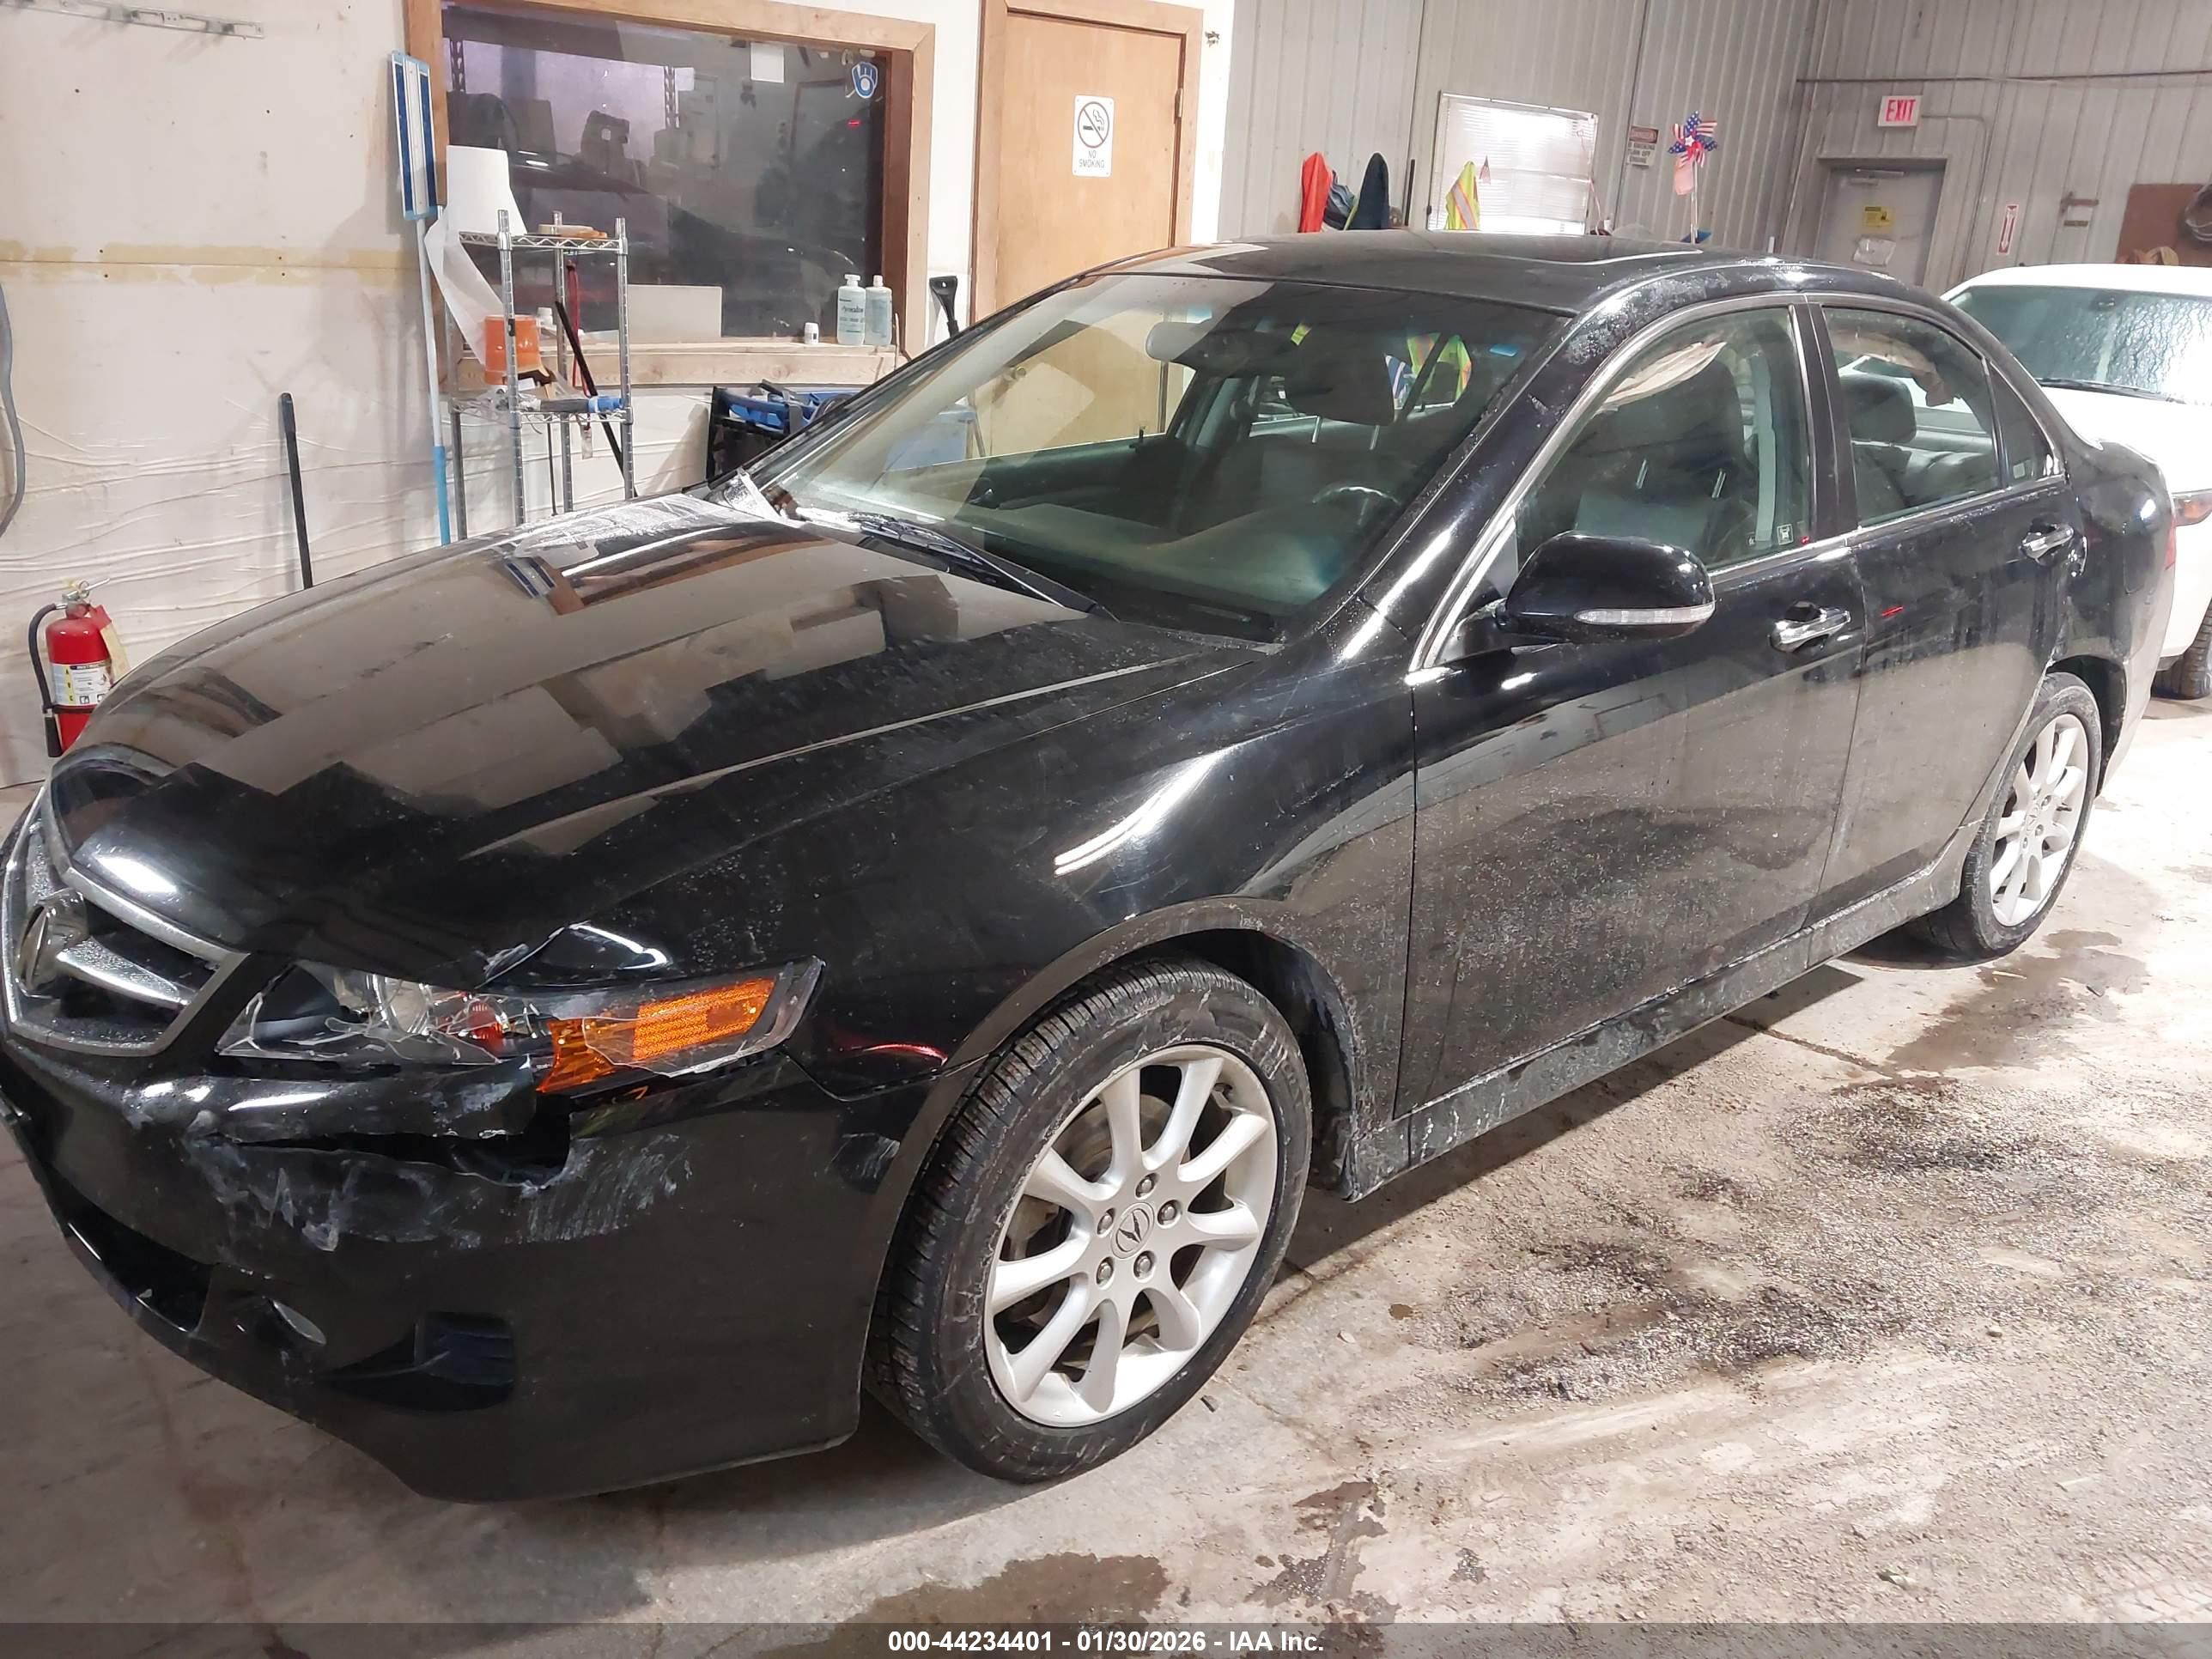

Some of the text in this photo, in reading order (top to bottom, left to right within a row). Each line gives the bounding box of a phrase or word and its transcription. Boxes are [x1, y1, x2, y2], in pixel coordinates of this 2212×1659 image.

[1886, 99, 1916, 122] EXIT
[1088, 149, 1097, 159] NO
[1079, 158, 1105, 168] SMOKING
